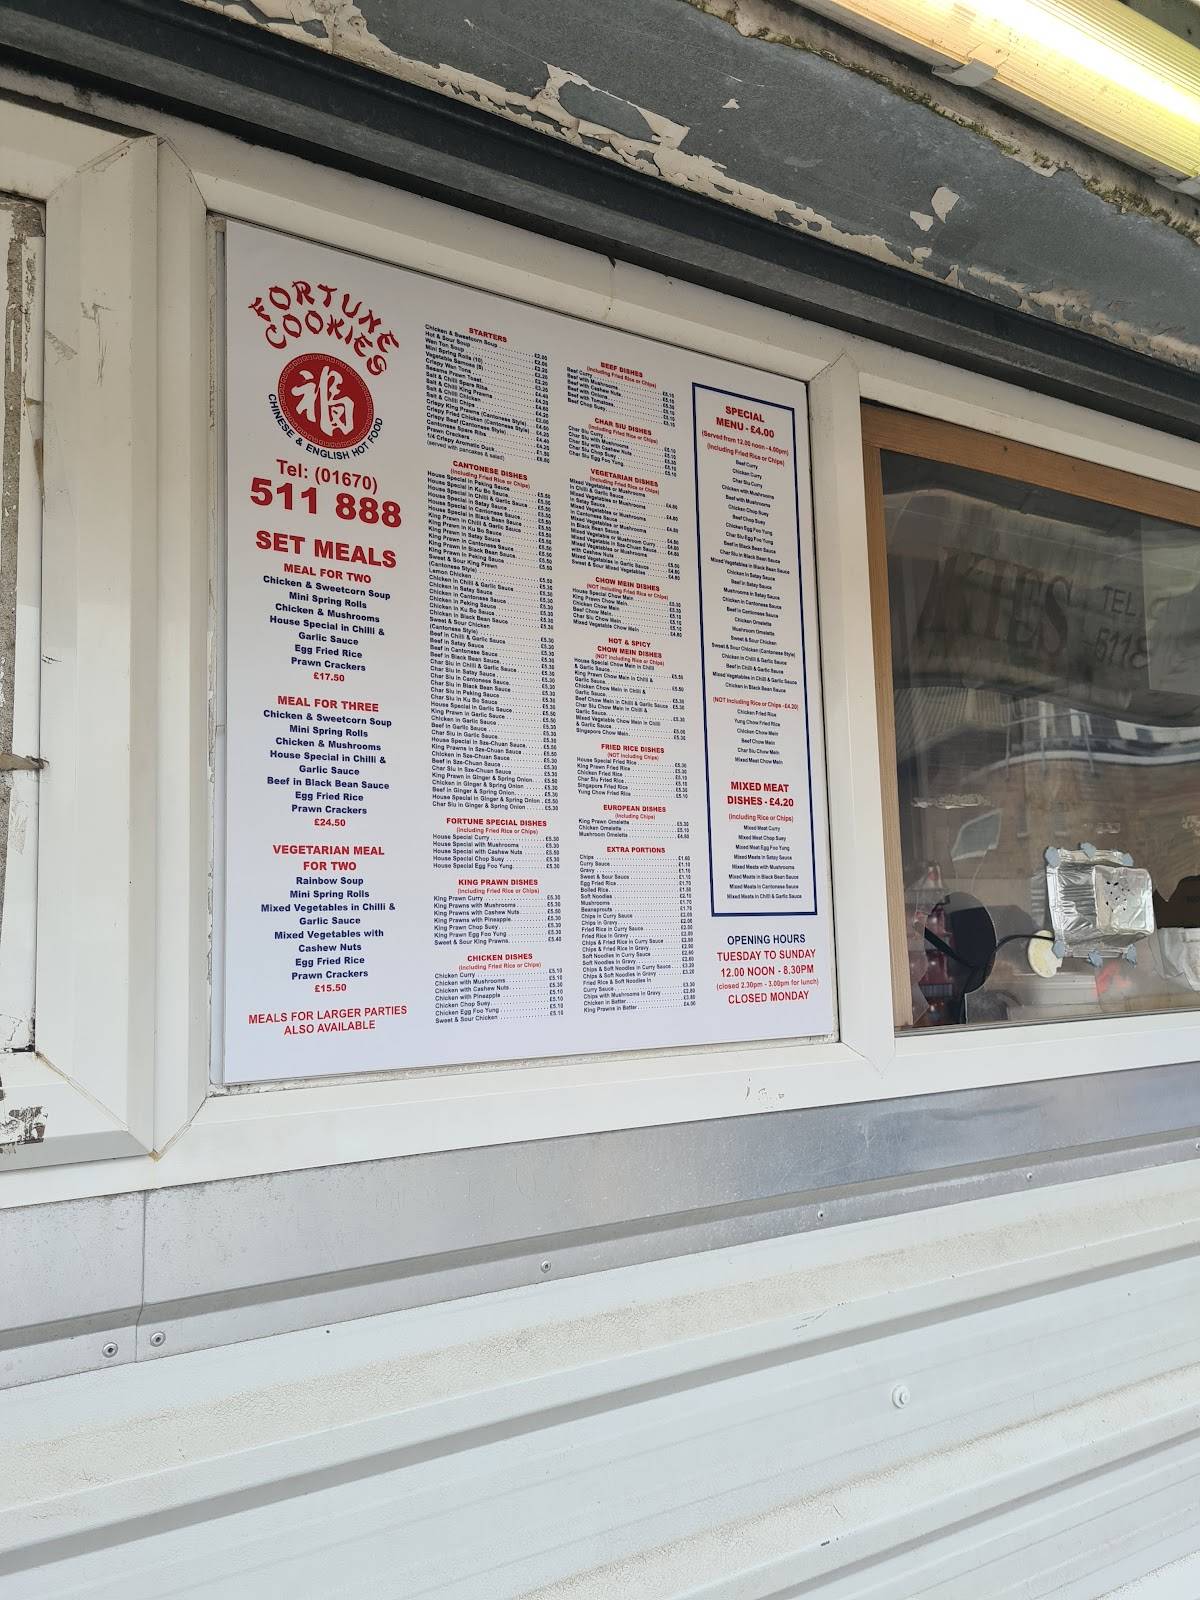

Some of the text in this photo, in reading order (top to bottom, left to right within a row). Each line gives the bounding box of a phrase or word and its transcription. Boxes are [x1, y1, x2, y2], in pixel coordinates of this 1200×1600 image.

[248, 281, 399, 353] FORTUNE
[468, 328, 507, 342] STARTERS
[265, 310, 387, 376] COOKIES
[601, 362, 642, 377] BEEF DISHES
[725, 406, 765, 422] SPECIAL
[268, 393, 383, 460] CHINESE & ENGLISH HOT FOOD
[595, 418, 613, 427] CHAR
[628, 425, 651, 435] DISHES
[716, 417, 774, 438] MENU £4.00
[276, 459, 378, 494] Tel: (01670)
[453, 461, 528, 480] CANTONESE DISHES
[591, 468, 658, 487] VEGETARIAN DISHES
[250, 477, 401, 528] 511 888
[256, 531, 396, 568] SET MEALS
[284, 563, 371, 583] MEAL FOR TWO
[263, 576, 301, 587] Chicken
[316, 583, 365, 596] Sweetcorn
[369, 590, 390, 600] Soup
[636, 583, 660, 592] DISHES
[289, 592, 367, 609] Mini Spring Rolls
[275, 603, 314, 615] Chicken
[328, 610, 380, 623] Mushrooms
[270, 616, 300, 625] House
[303, 620, 338, 630] Special
[352, 626, 374, 634] Chilli
[299, 632, 358, 645] Garlic Sauce
[295, 644, 362, 658] Egg Fried Rice
[291, 657, 366, 671] Prawn Crackers
[314, 672, 344, 681] £17.50
[278, 696, 379, 712] MEAL FOR THREE
[267, 777, 290, 785] Beef
[305, 779, 331, 787] Black
[335, 780, 358, 788] Bean
[362, 781, 389, 789] Sauce
[731, 781, 789, 792] MIXED MEAT
[727, 796, 794, 806] DISHES £4.20
[273, 845, 384, 855] VEGETARIAN MEAL
[303, 862, 356, 870] FOR TWO
[340, 877, 363, 886] Soup
[261, 904, 290, 912] Mixed
[294, 903, 348, 913] Vegetables
[275, 929, 384, 940] Mixed Vegetables with
[727, 934, 805, 945] OPENING HOURS
[298, 944, 336, 953] Cashew
[717, 949, 816, 961] TUESDAY TO SUNDAY
[721, 964, 813, 977] 12.00 NOON 8.30PM
[315, 984, 346, 992] £15.50
[717, 983, 739, 991] (closed
[801, 978, 819, 987] lunch)
[728, 991, 809, 1004] CLOSED MONDAY
[249, 1006, 407, 1024] MEALS FOR LARGER PARTIES
[284, 1020, 375, 1035] ALSO AVAILABLE
